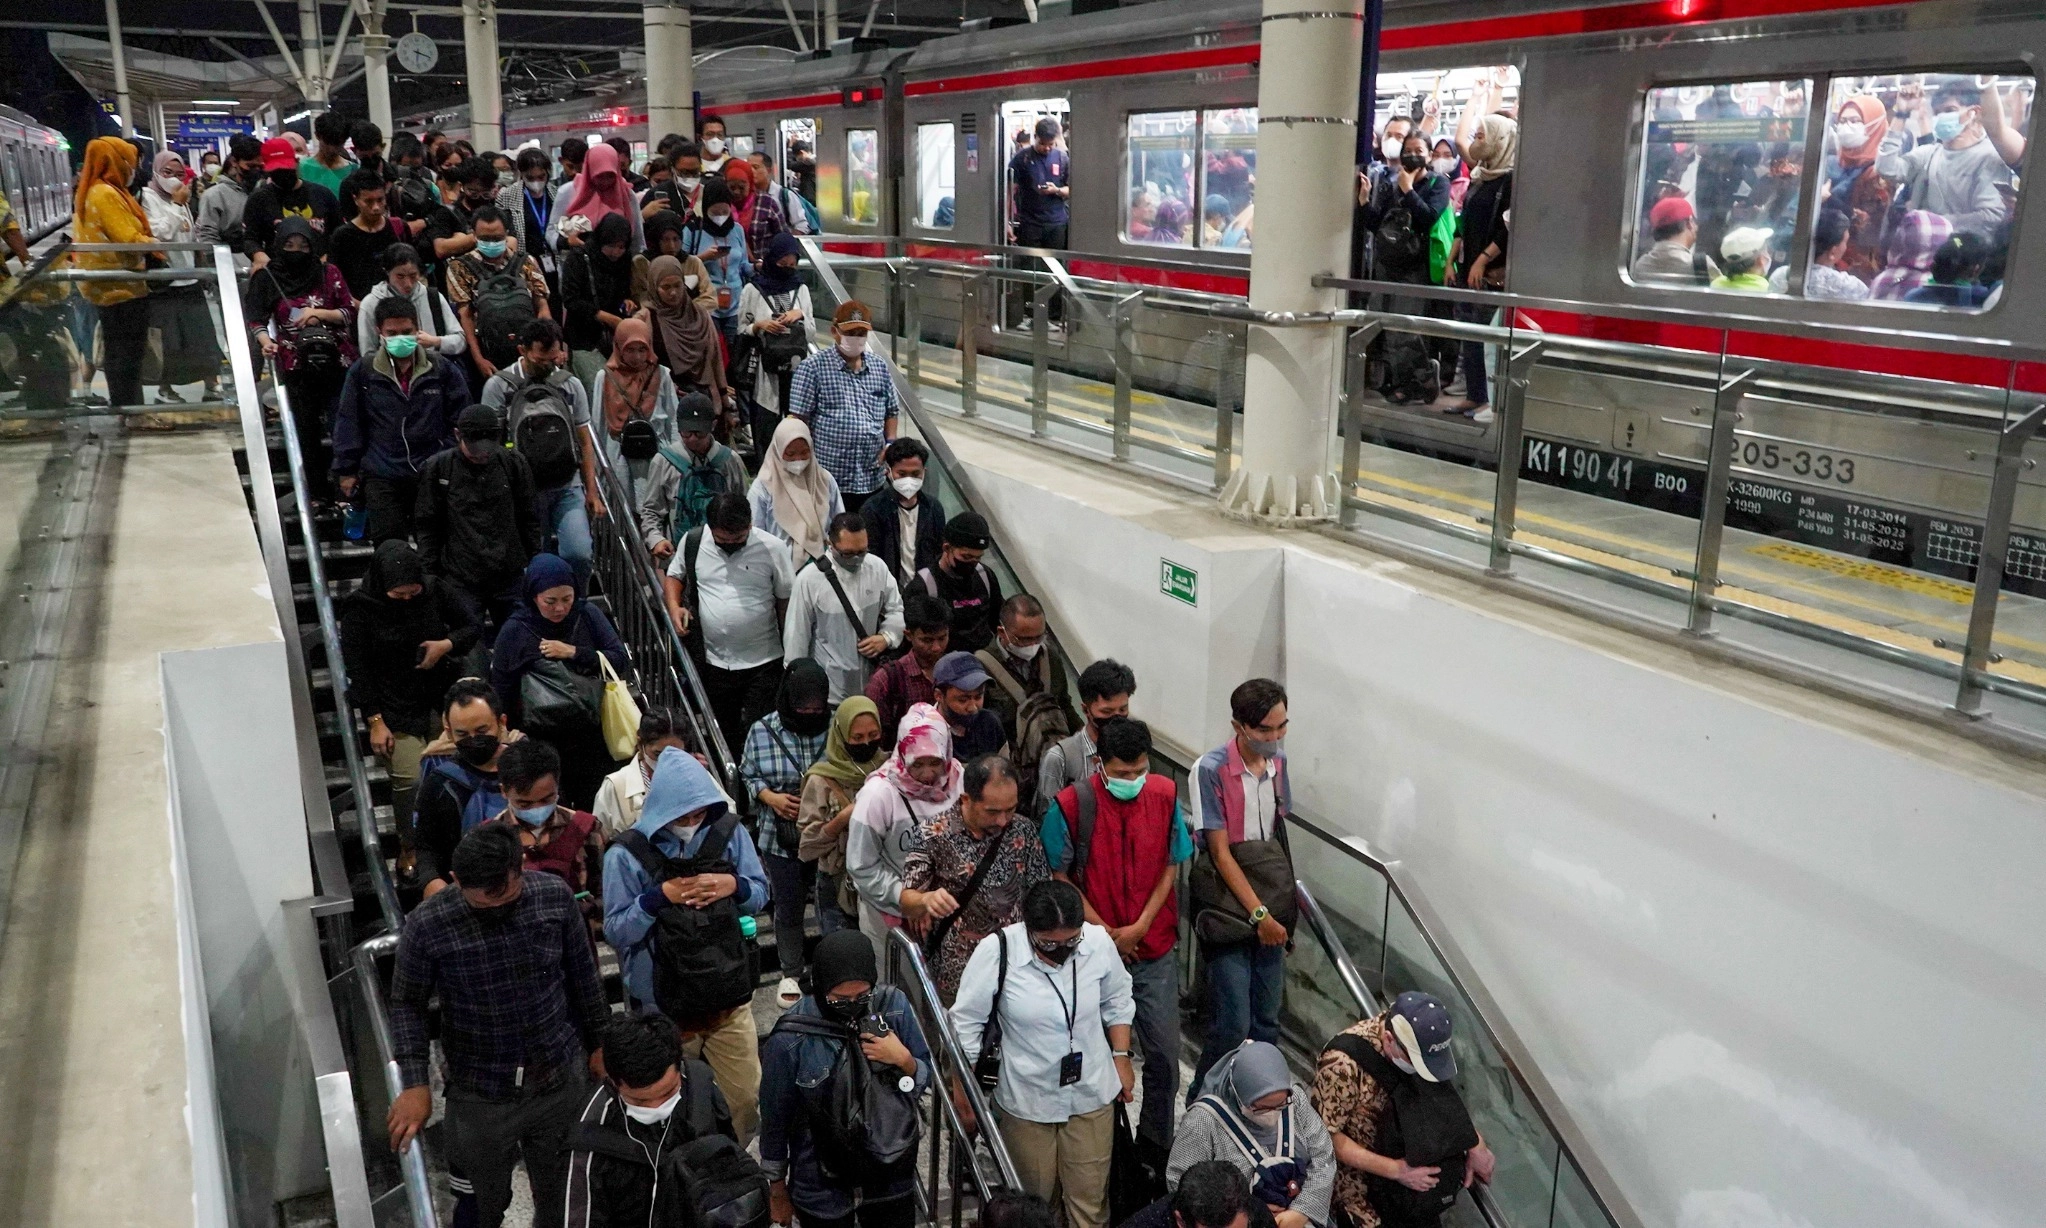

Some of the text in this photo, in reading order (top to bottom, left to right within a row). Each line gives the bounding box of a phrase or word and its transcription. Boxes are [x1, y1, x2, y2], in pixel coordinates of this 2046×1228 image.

[101, 103, 115, 113] 13
[1607, 456, 1633, 491] 41
[1734, 498, 1762, 515] 1990
[1847, 504, 1907, 525] 17-03-2014
[1843, 517, 1906, 538] 31-05-2023
[1843, 529, 1904, 551] 31-05-2025
